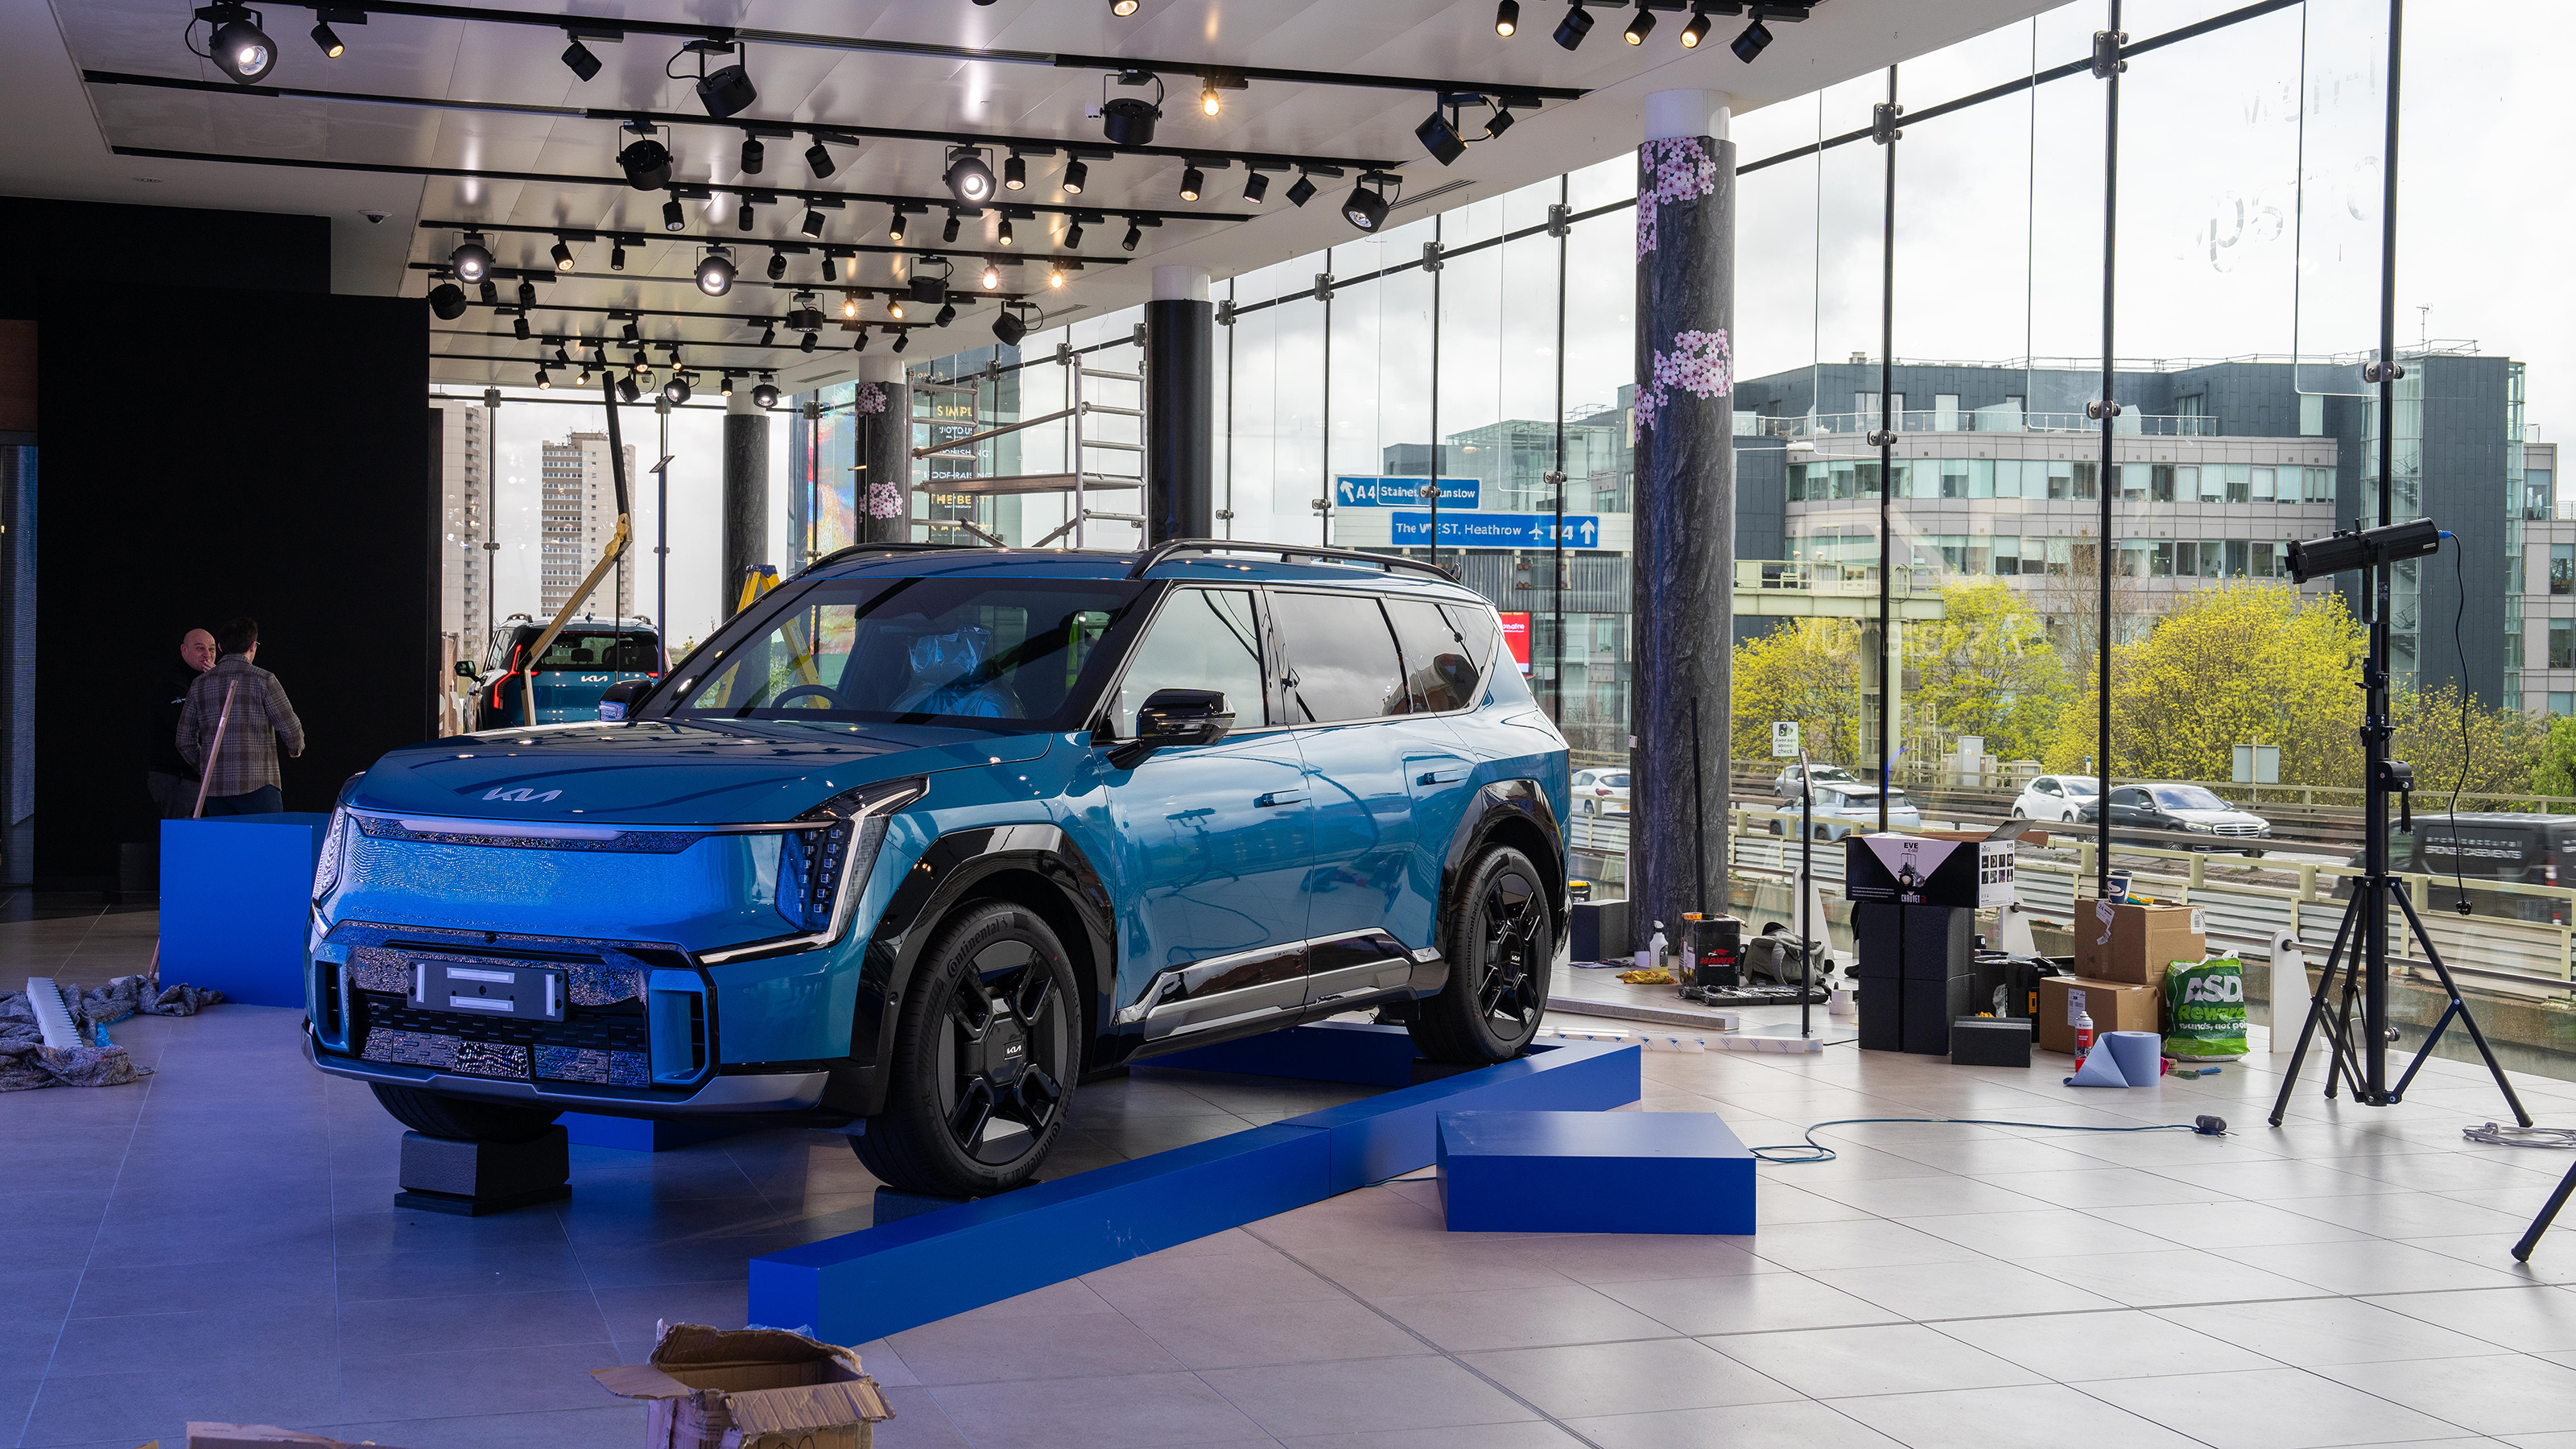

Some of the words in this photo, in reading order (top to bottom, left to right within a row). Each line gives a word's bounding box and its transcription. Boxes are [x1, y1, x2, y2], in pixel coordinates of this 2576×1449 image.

[937, 405, 974, 417] SIMPL
[1356, 485, 1376, 499] A4
[1436, 488, 1476, 498] unslow
[1396, 522, 1416, 534] The
[1464, 524, 1521, 535] Heathrow
[580, 674, 609, 683] KIA
[483, 787, 563, 803] KIA
[1901, 894, 1920, 903] CHAUVET
[2098, 903, 2104, 911] 24
[947, 918, 1000, 979] Continental
[2183, 974, 2244, 1005] ASD
[1006, 1044, 1022, 1055] KIA
